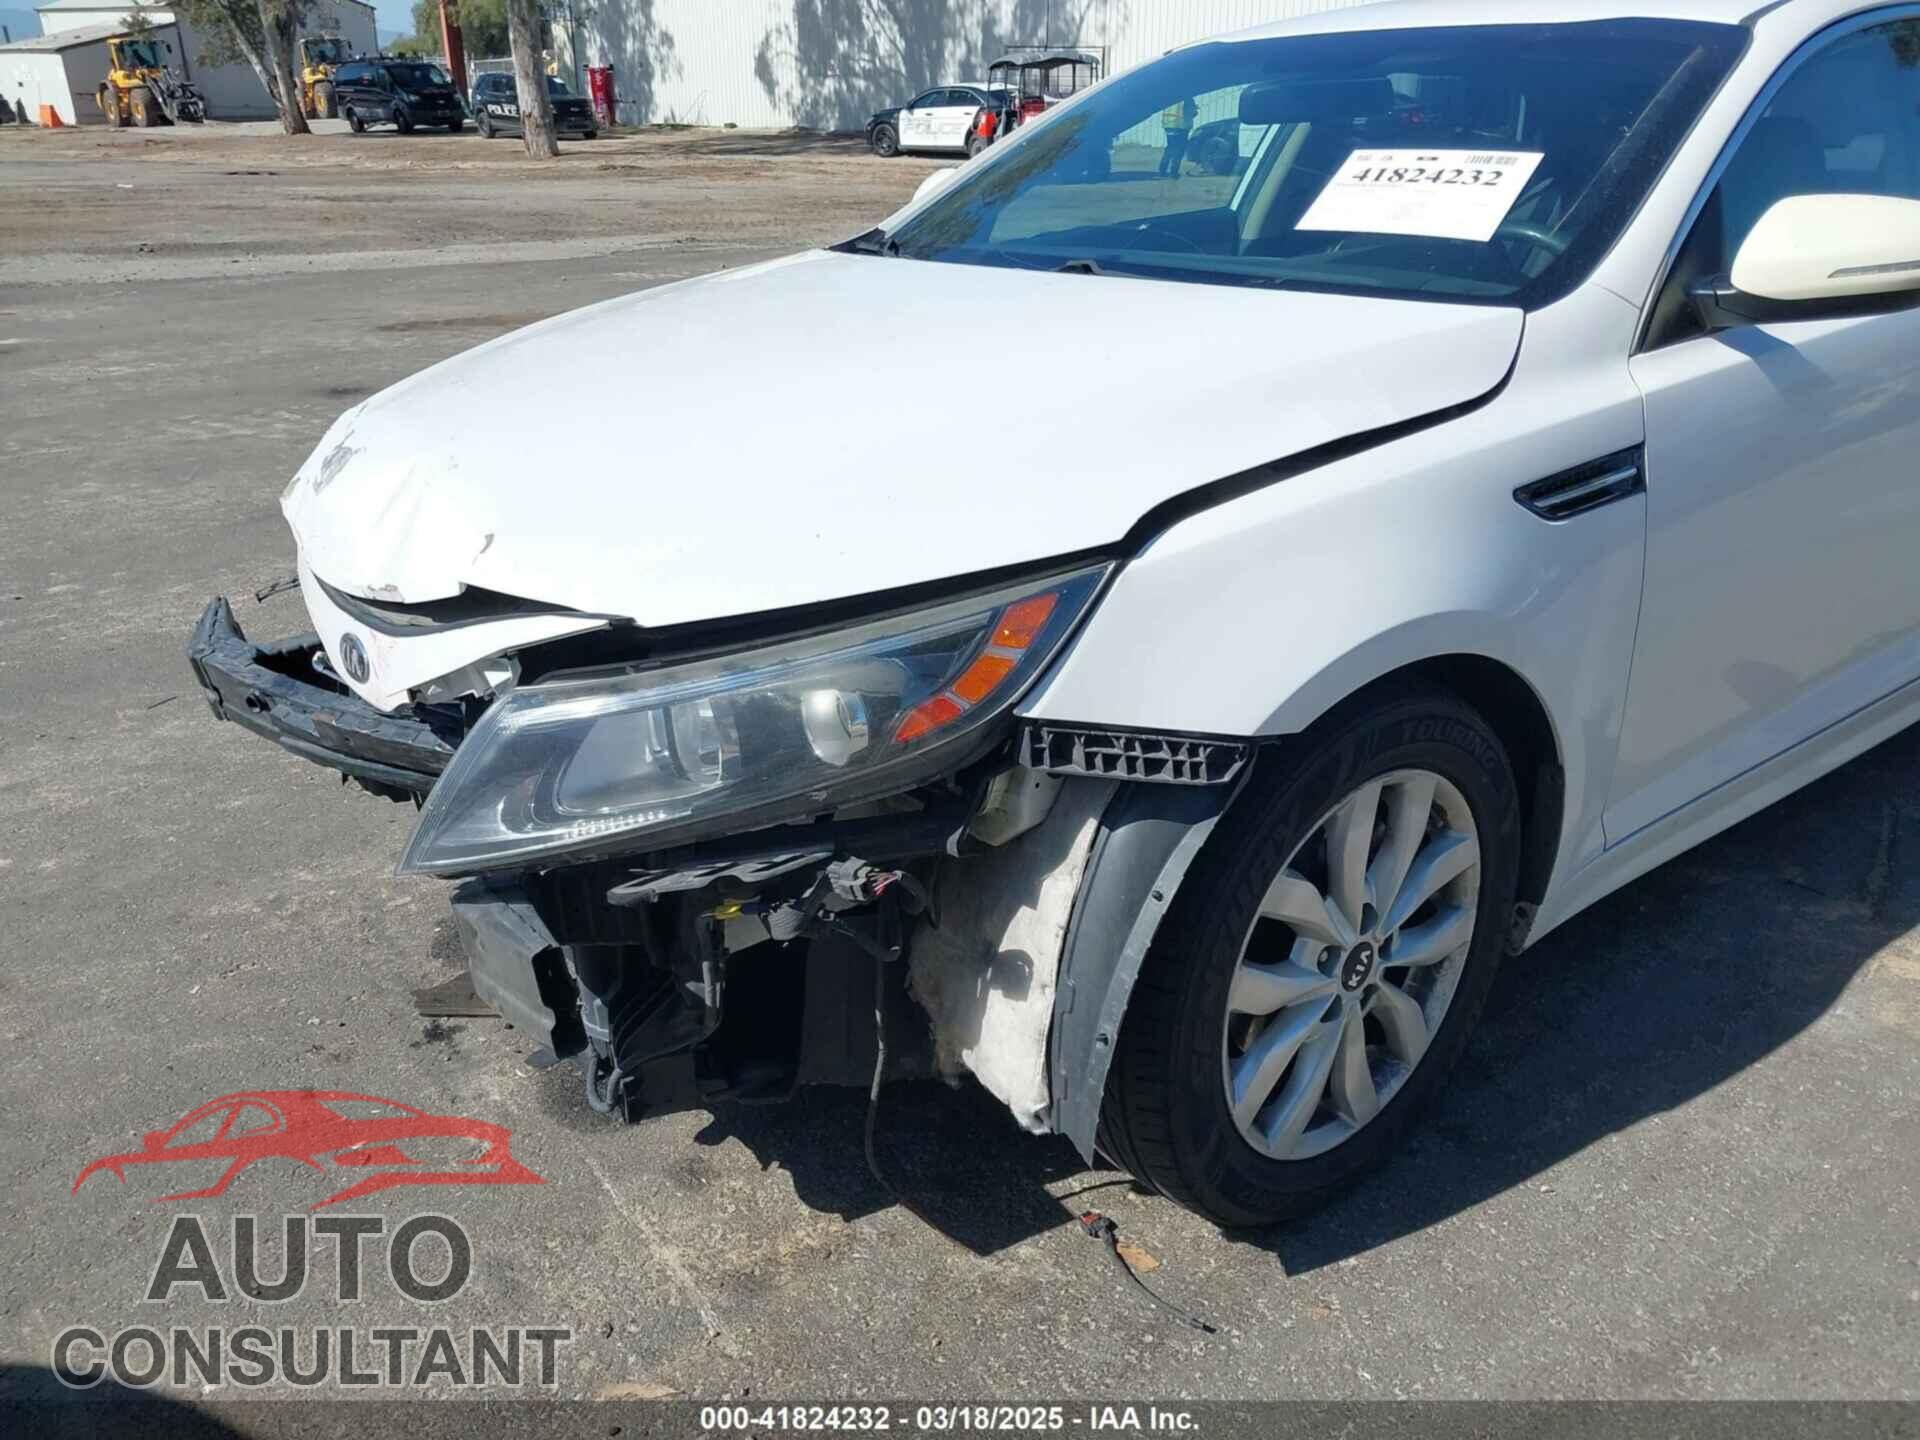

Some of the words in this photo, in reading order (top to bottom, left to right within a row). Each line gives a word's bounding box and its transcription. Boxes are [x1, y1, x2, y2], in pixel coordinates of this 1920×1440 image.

[487, 104, 520, 117] POLICE
[1352, 167, 1504, 186] 41824232
[1347, 949, 1372, 988] KIA
